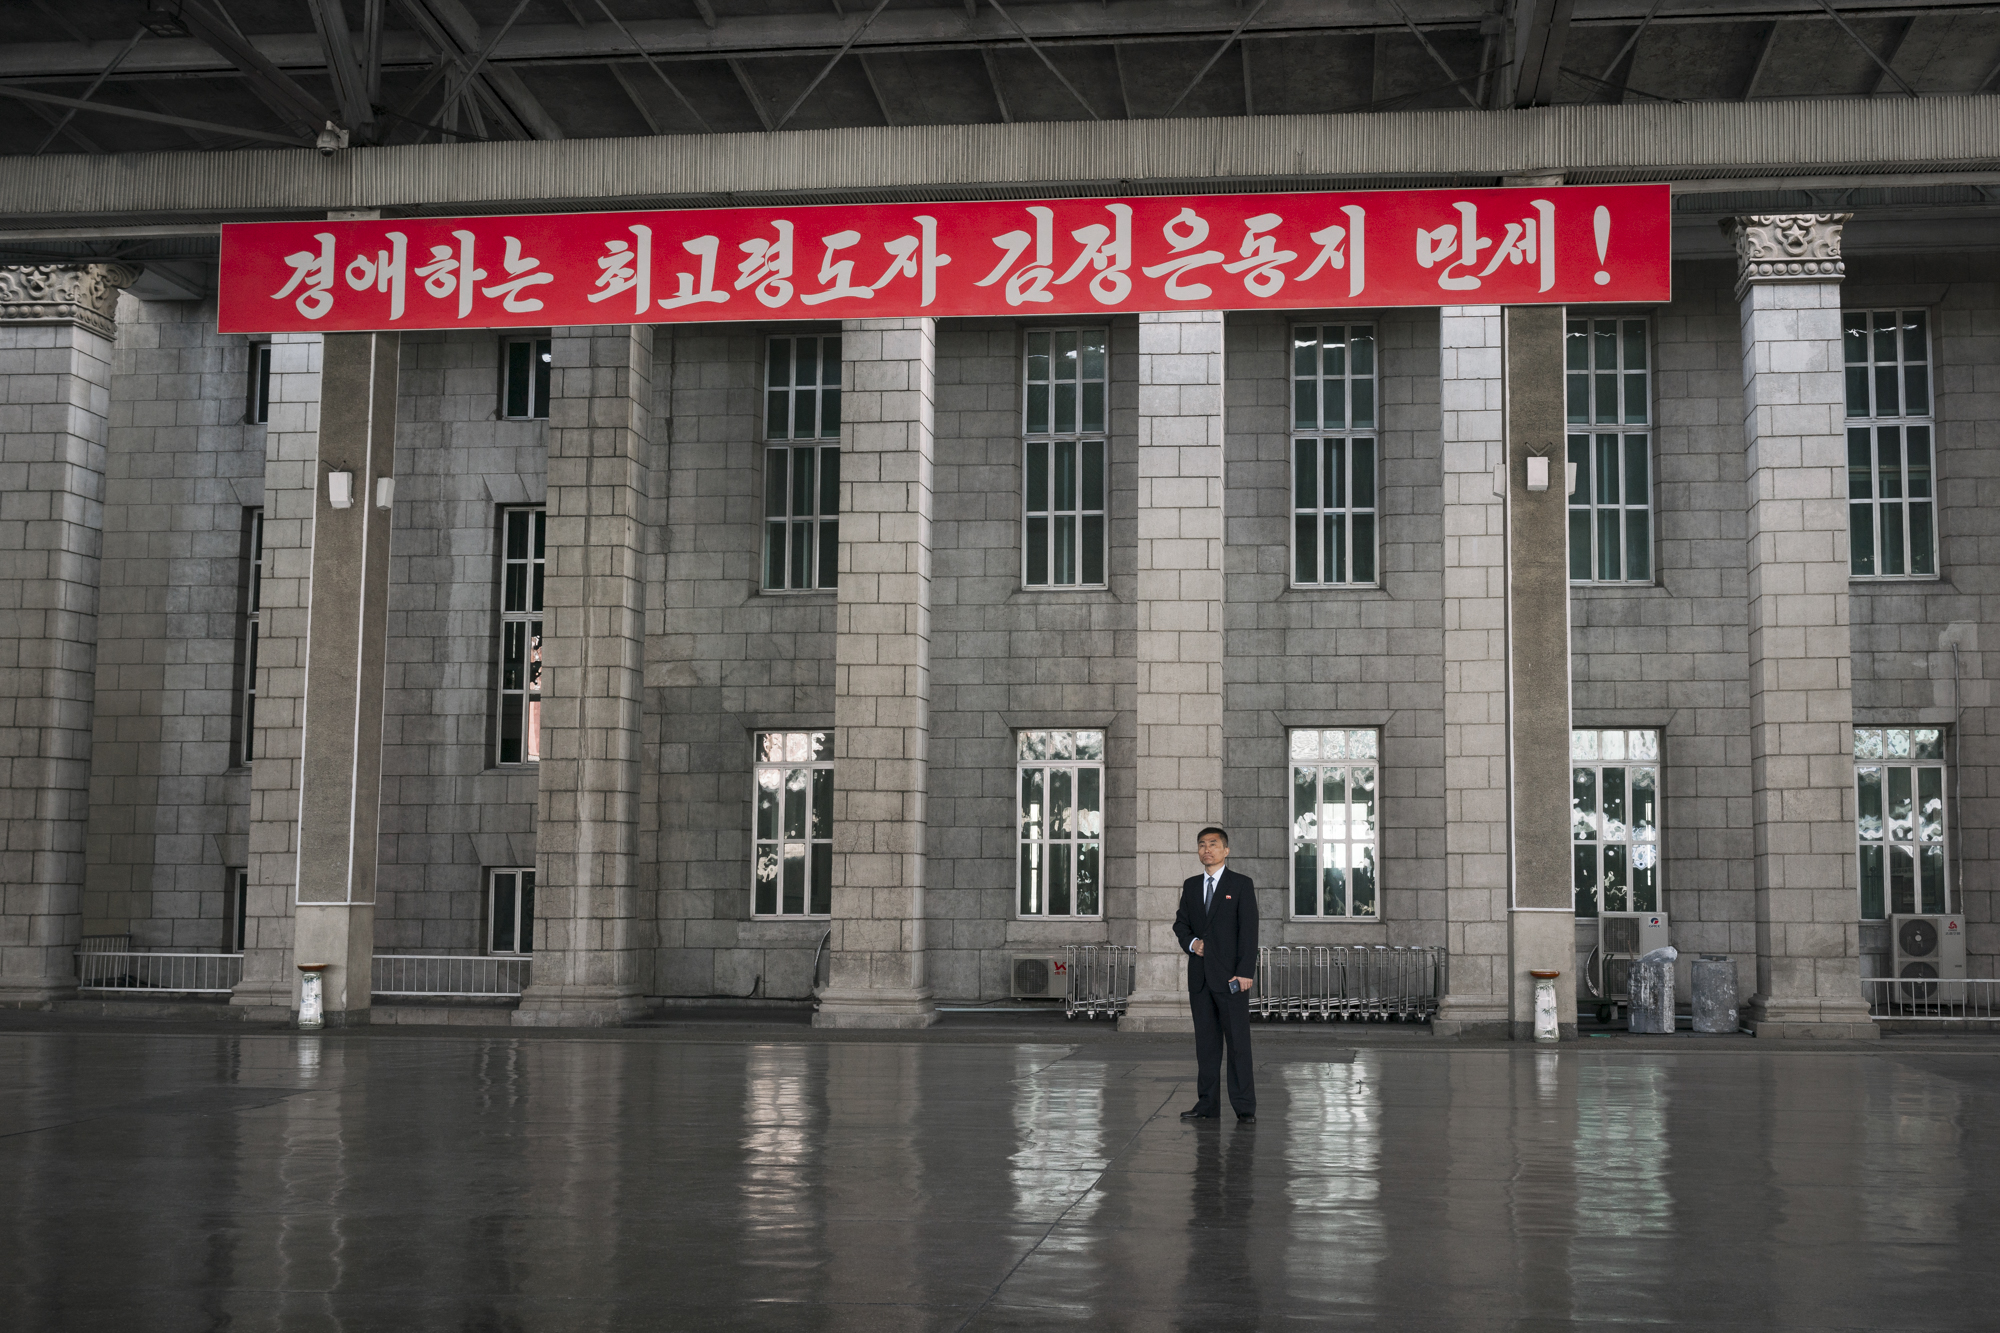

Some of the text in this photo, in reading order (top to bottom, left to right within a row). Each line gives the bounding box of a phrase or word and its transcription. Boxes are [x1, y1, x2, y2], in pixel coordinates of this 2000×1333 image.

[270, 229, 554, 321] 경애하는
[587, 215, 952, 315] 최고령도자
[973, 203, 1366, 308] 김정은동지
